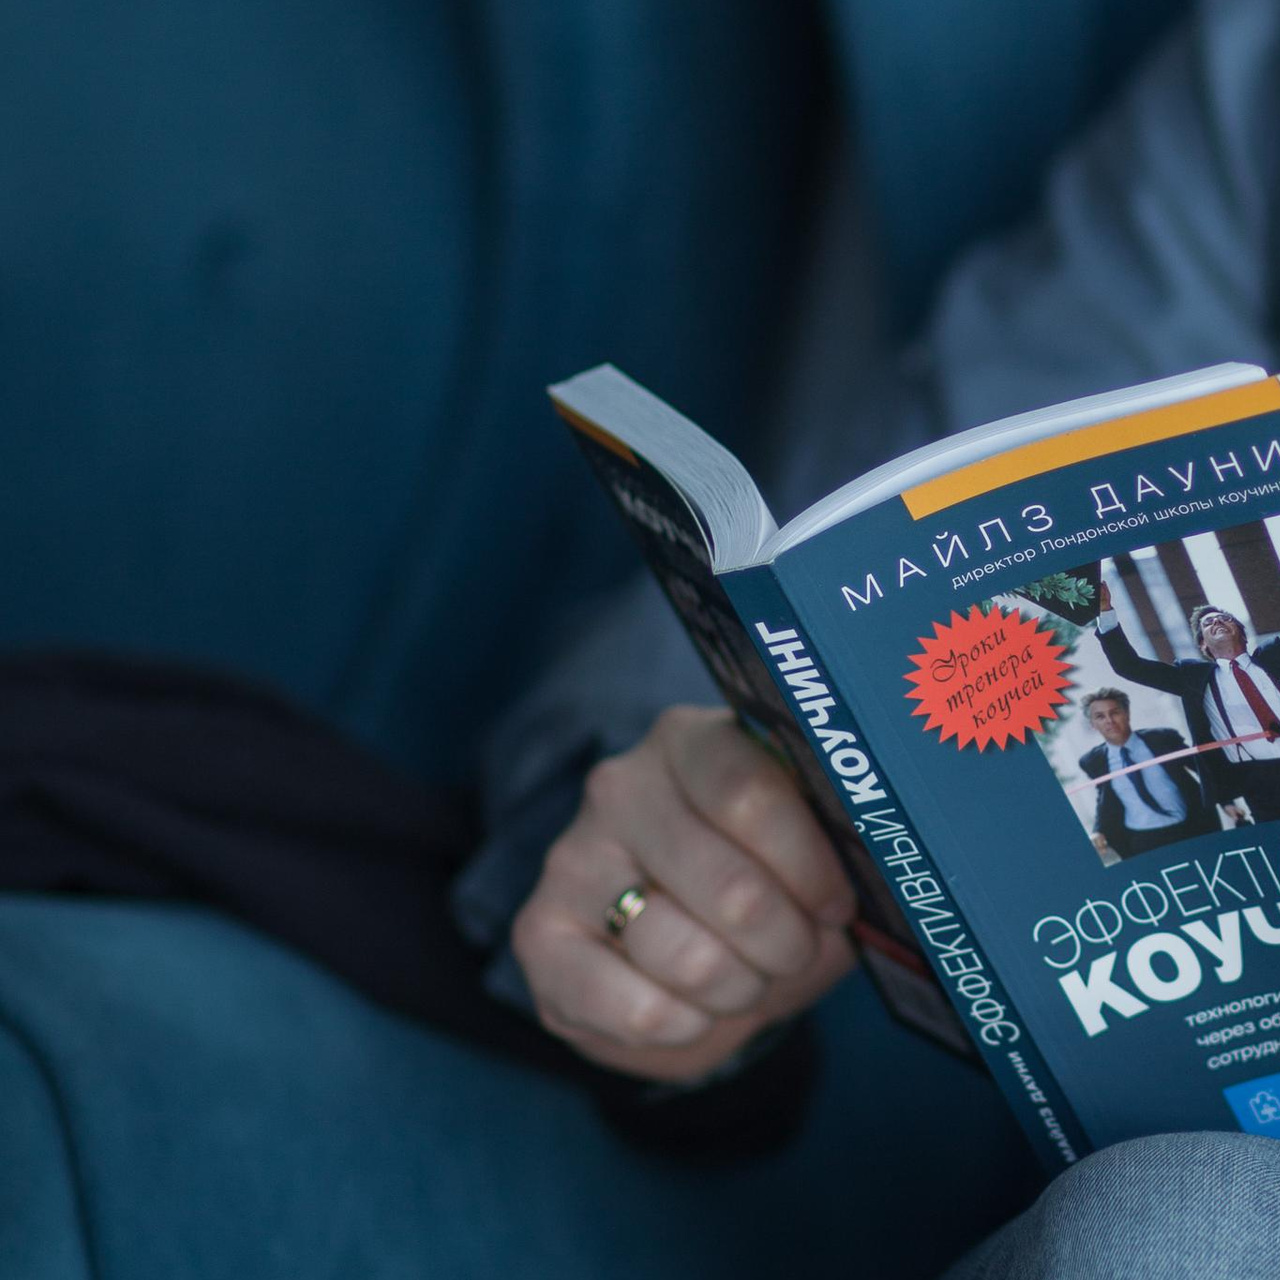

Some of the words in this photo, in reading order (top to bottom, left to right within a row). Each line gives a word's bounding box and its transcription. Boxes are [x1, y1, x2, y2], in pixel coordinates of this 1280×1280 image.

[840, 504, 1055, 612] МАЙЛЗ
[951, 548, 1036, 590] директор
[1041, 511, 1150, 555] Лондонской
[1153, 498, 1214, 521] школы
[930, 628, 1007, 682] Уроки
[946, 644, 1034, 713] тренера
[755, 621, 888, 805] КОУЧИНГ
[972, 670, 1045, 729] коучей
[854, 807, 1021, 1046] ЭФФЕКТИВНЫЙ
[1196, 1023, 1255, 1047] через
[1008, 1050, 1047, 1103] ДАУНИ
